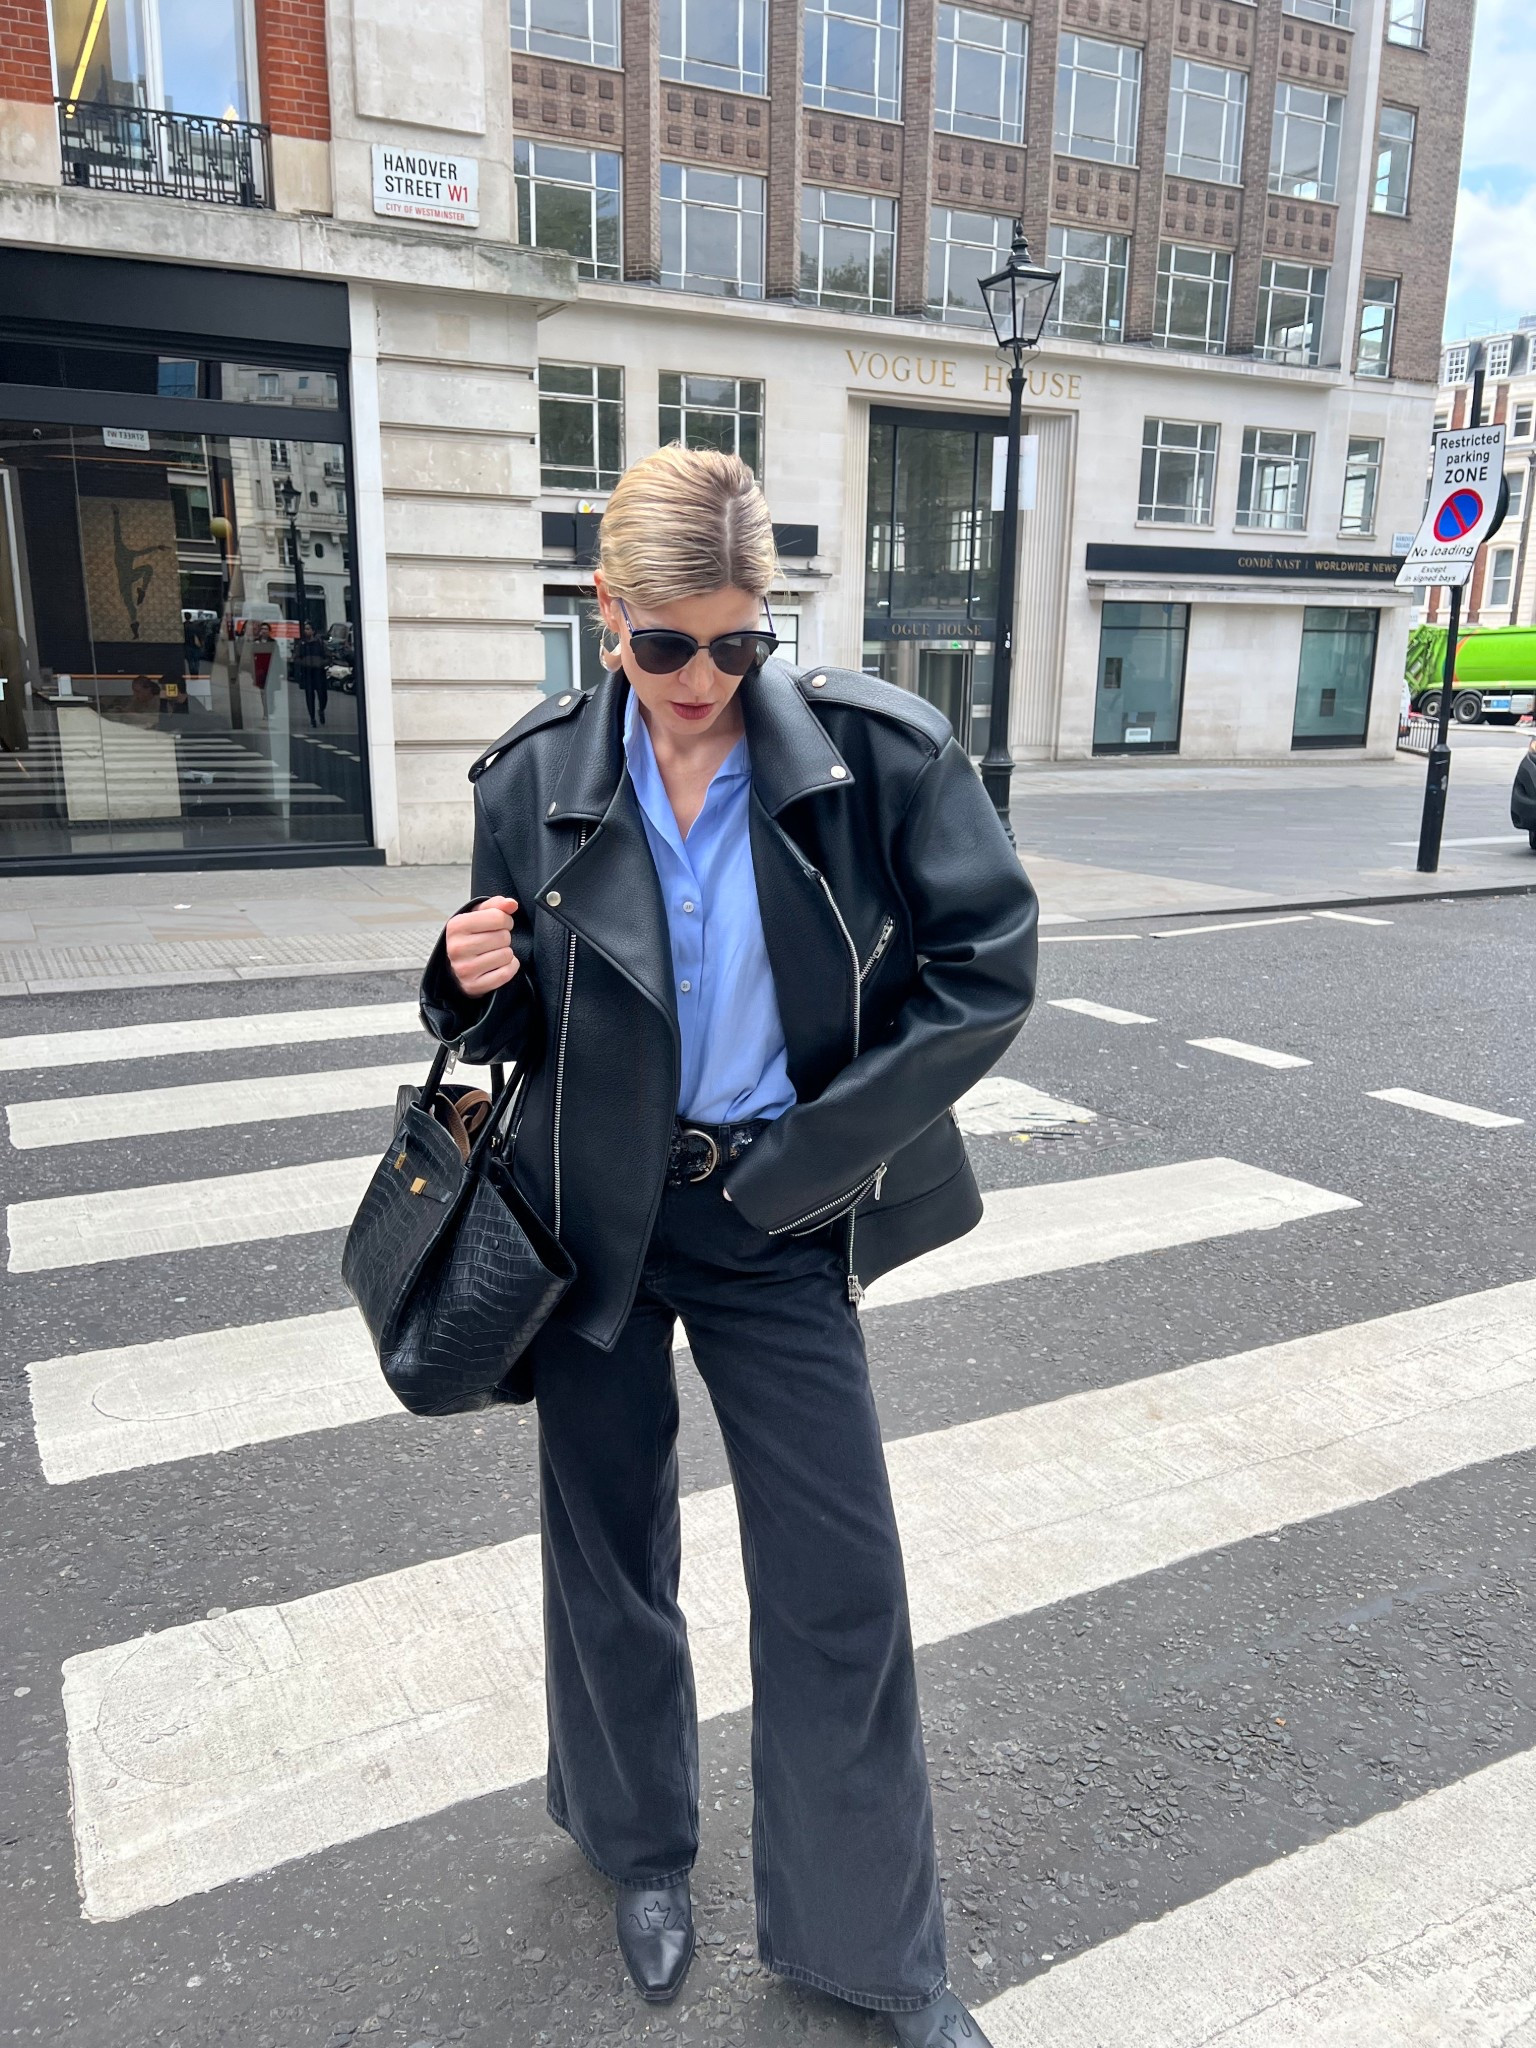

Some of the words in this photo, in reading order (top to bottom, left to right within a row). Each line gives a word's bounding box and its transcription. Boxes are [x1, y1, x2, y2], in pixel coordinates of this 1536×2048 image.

[383, 152, 458, 181] HANOVER
[384, 175, 442, 199] STREET
[448, 184, 468, 203] W1
[385, 203, 402, 212] CITY
[404, 204, 413, 213] OF
[415, 207, 465, 221] WESTMINSTER
[845, 349, 957, 388] VOGUE
[983, 364, 1082, 400] HUSE
[1440, 431, 1500, 450] Restricted
[1446, 450, 1490, 467] parking
[1444, 466, 1488, 484] ZONE
[1411, 547, 1428, 558] No
[1430, 544, 1474, 557] loading
[1237, 554, 1273, 569] CONDÉ
[1276, 558, 1302, 570] NAST
[1314, 560, 1370, 573] WORLDWIDE
[1372, 563, 1398, 574] NEWS
[1421, 565, 1447, 574] Except
[1413, 575, 1438, 583] signed
[1438, 574, 1457, 583] bays
[937, 623, 982, 637] HOUSE
